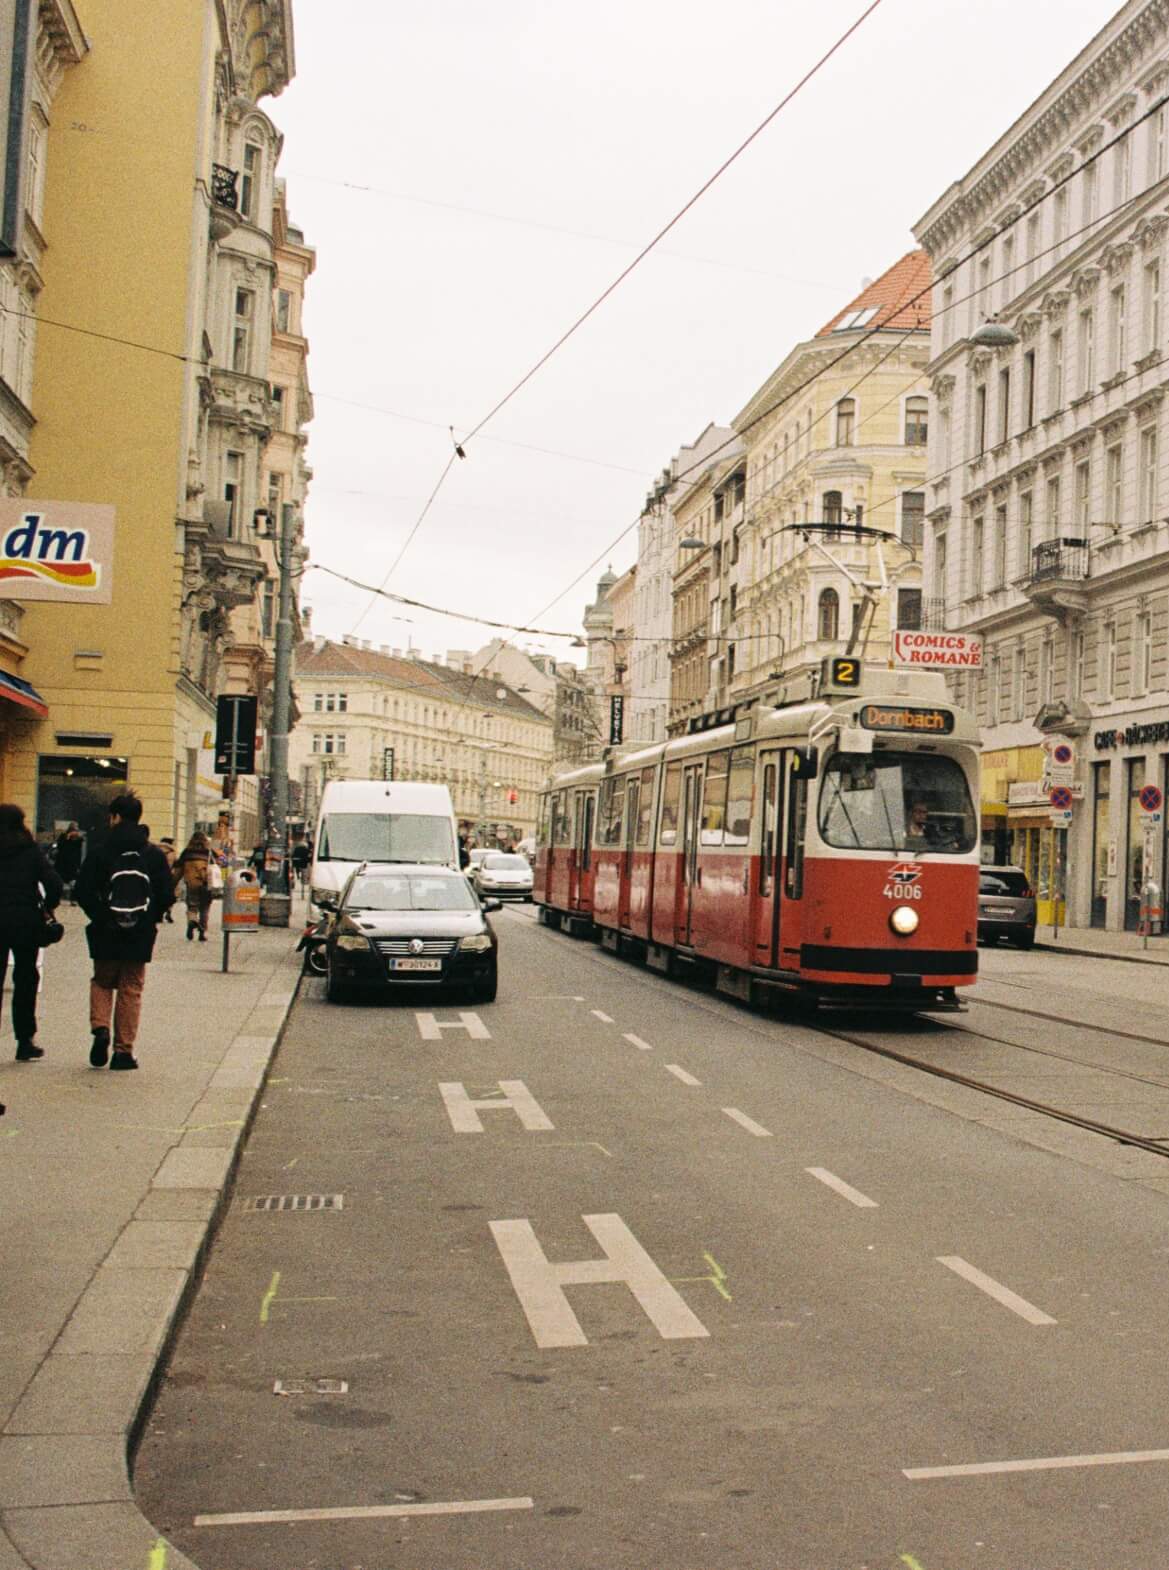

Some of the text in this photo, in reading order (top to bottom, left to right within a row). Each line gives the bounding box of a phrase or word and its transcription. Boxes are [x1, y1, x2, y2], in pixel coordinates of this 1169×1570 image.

[5, 515, 86, 561] dm
[903, 634, 980, 653] COMICS &
[910, 650, 981, 666] ROMANE
[838, 663, 853, 681] 2
[867, 705, 945, 729] Dornbach
[883, 883, 922, 900] 4006
[415, 1012, 492, 1040] H
[438, 1079, 556, 1133] H
[488, 1212, 711, 1349] H
